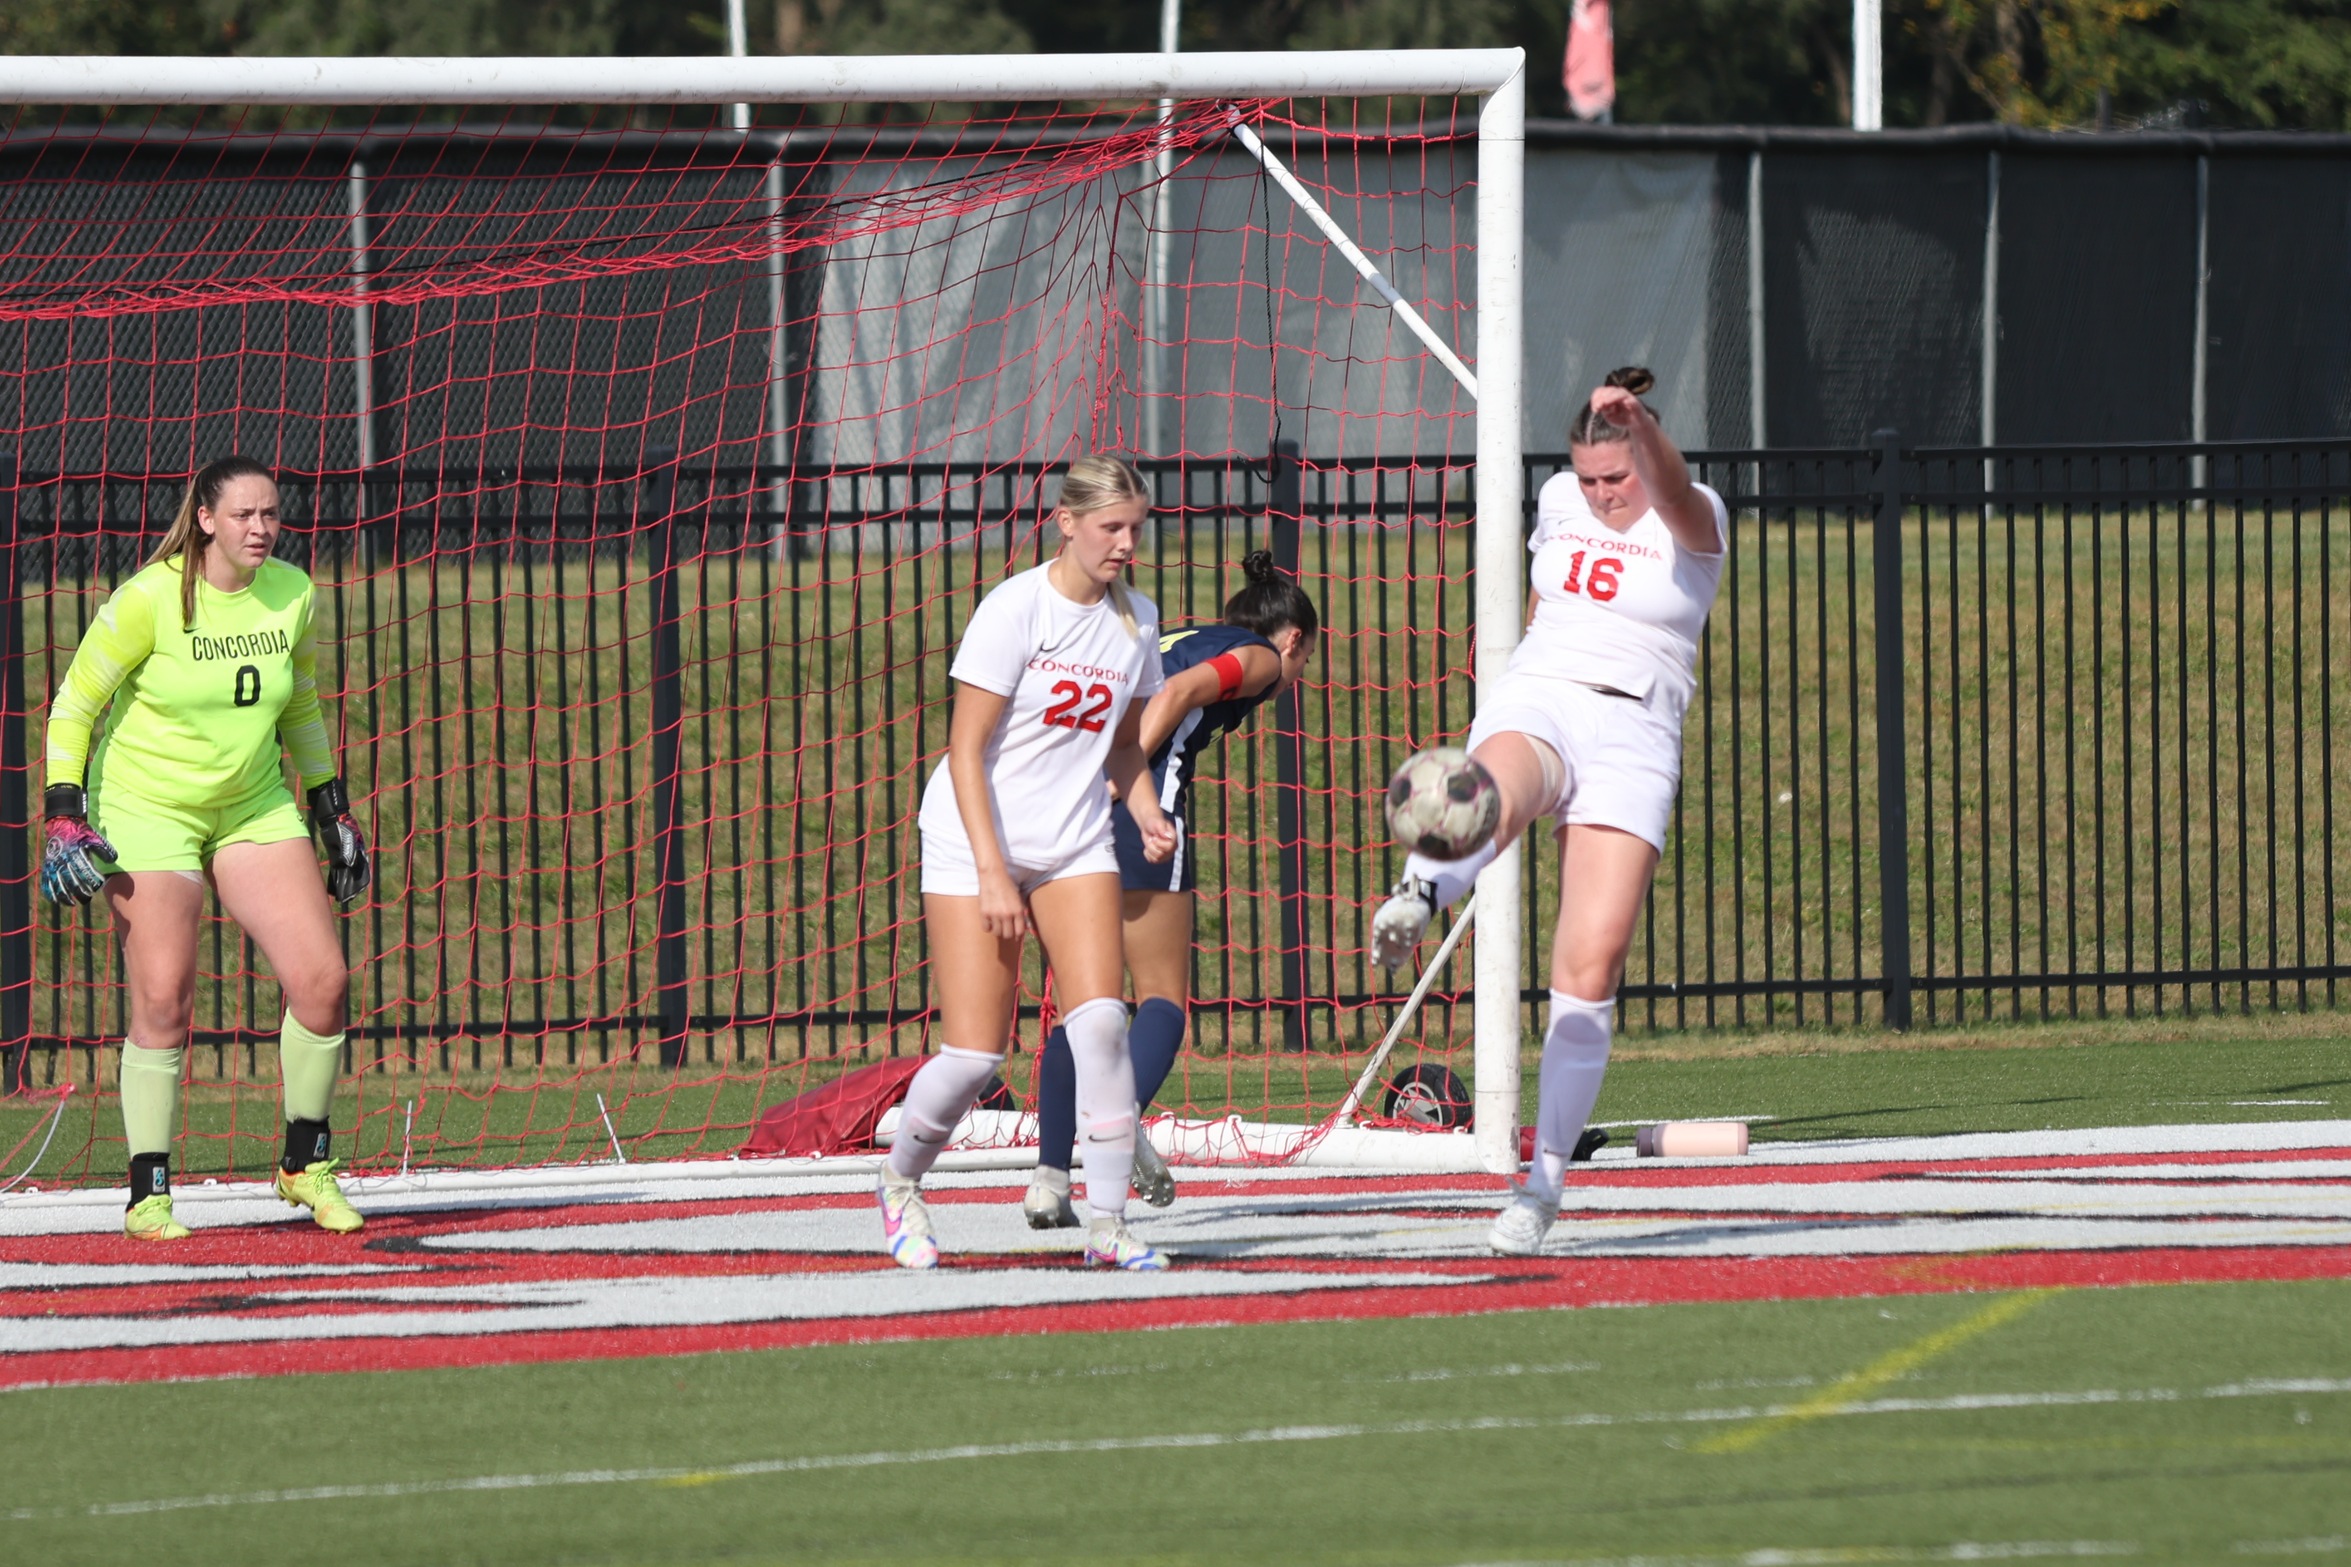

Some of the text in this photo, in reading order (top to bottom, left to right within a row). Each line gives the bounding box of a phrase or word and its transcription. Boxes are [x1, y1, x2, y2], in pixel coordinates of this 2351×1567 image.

[1563, 550, 1624, 602] 16
[192, 629, 290, 661] CONCORDIA
[233, 664, 261, 705] 0
[1027, 659, 1129, 685] CONCORDIA
[1042, 680, 1113, 733] 22
